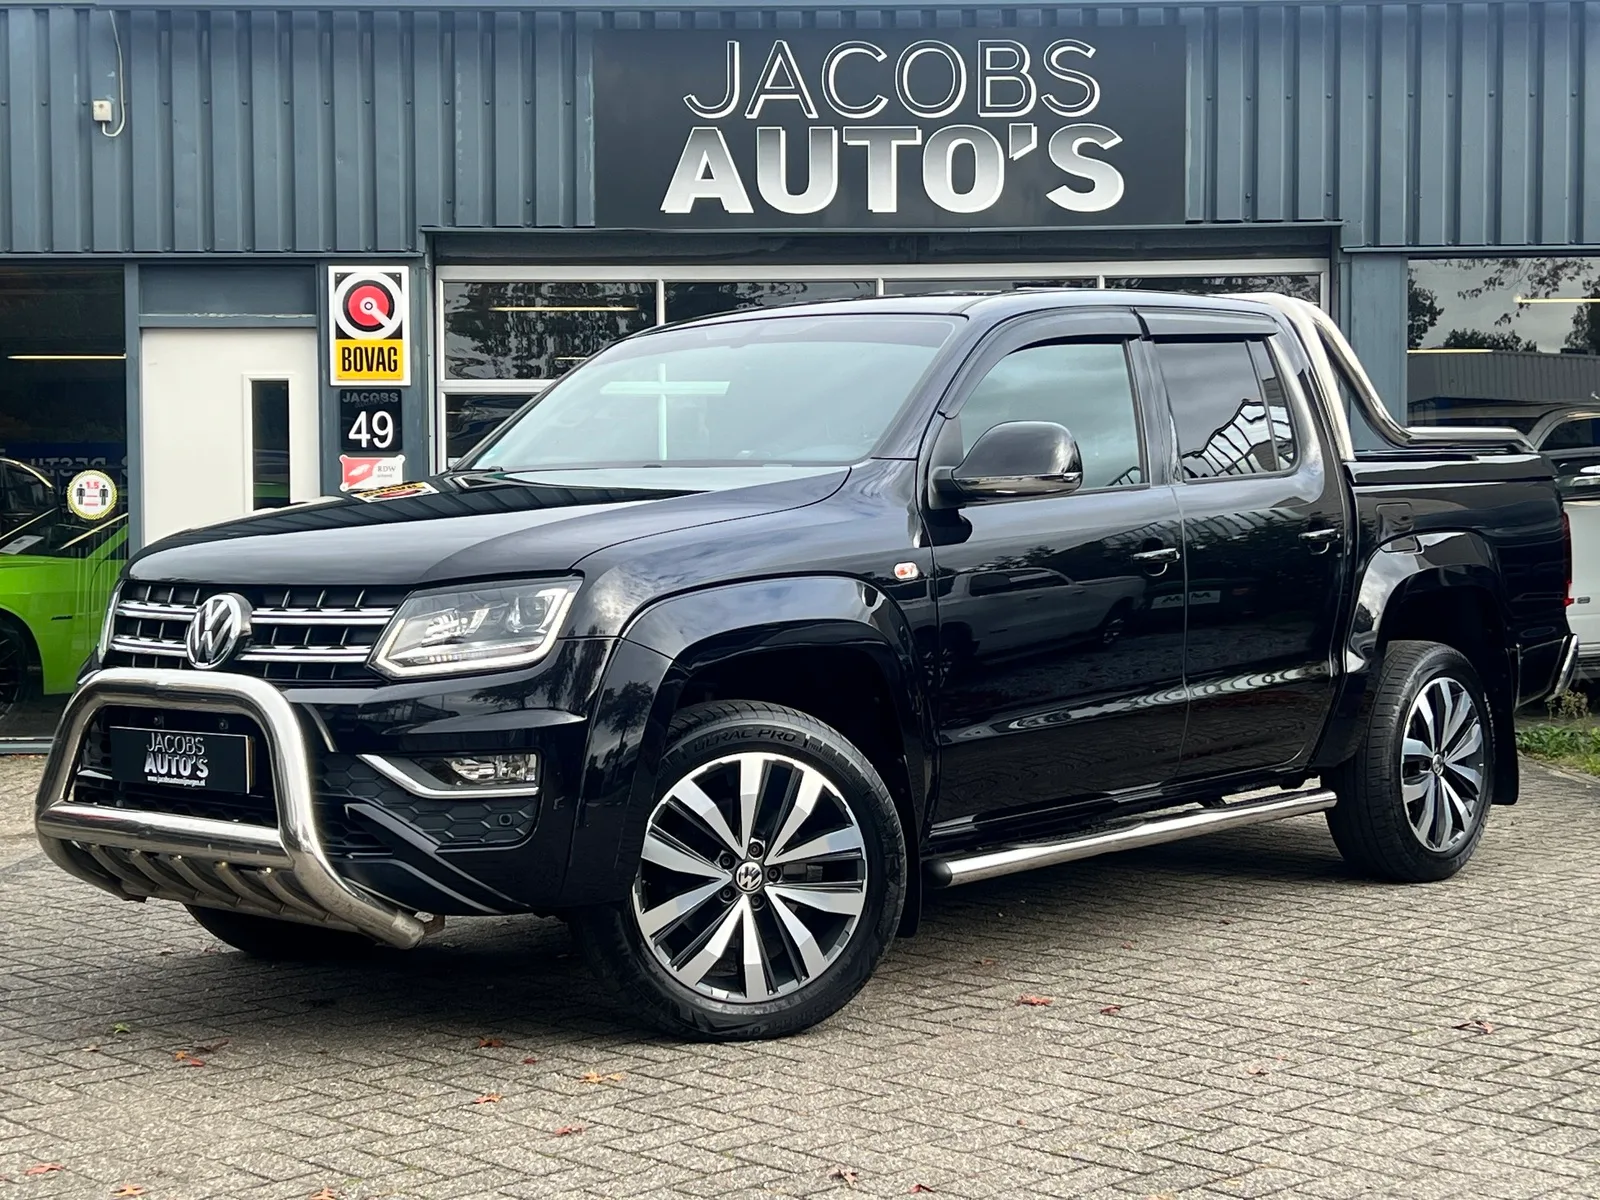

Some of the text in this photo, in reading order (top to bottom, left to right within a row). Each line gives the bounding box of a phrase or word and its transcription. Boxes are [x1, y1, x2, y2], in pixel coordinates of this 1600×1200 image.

[683, 38, 1100, 118] JACOBS
[660, 123, 1125, 214] AUTO'S
[341, 346, 398, 373] BOVAG
[342, 392, 399, 403] JACOBS
[348, 410, 394, 449] 49
[377, 465, 396, 473] RDW
[85, 481, 100, 490] 1.5
[146, 732, 205, 755] JACOBS
[757, 728, 797, 743] PRO
[144, 752, 209, 778] AUTO'S
